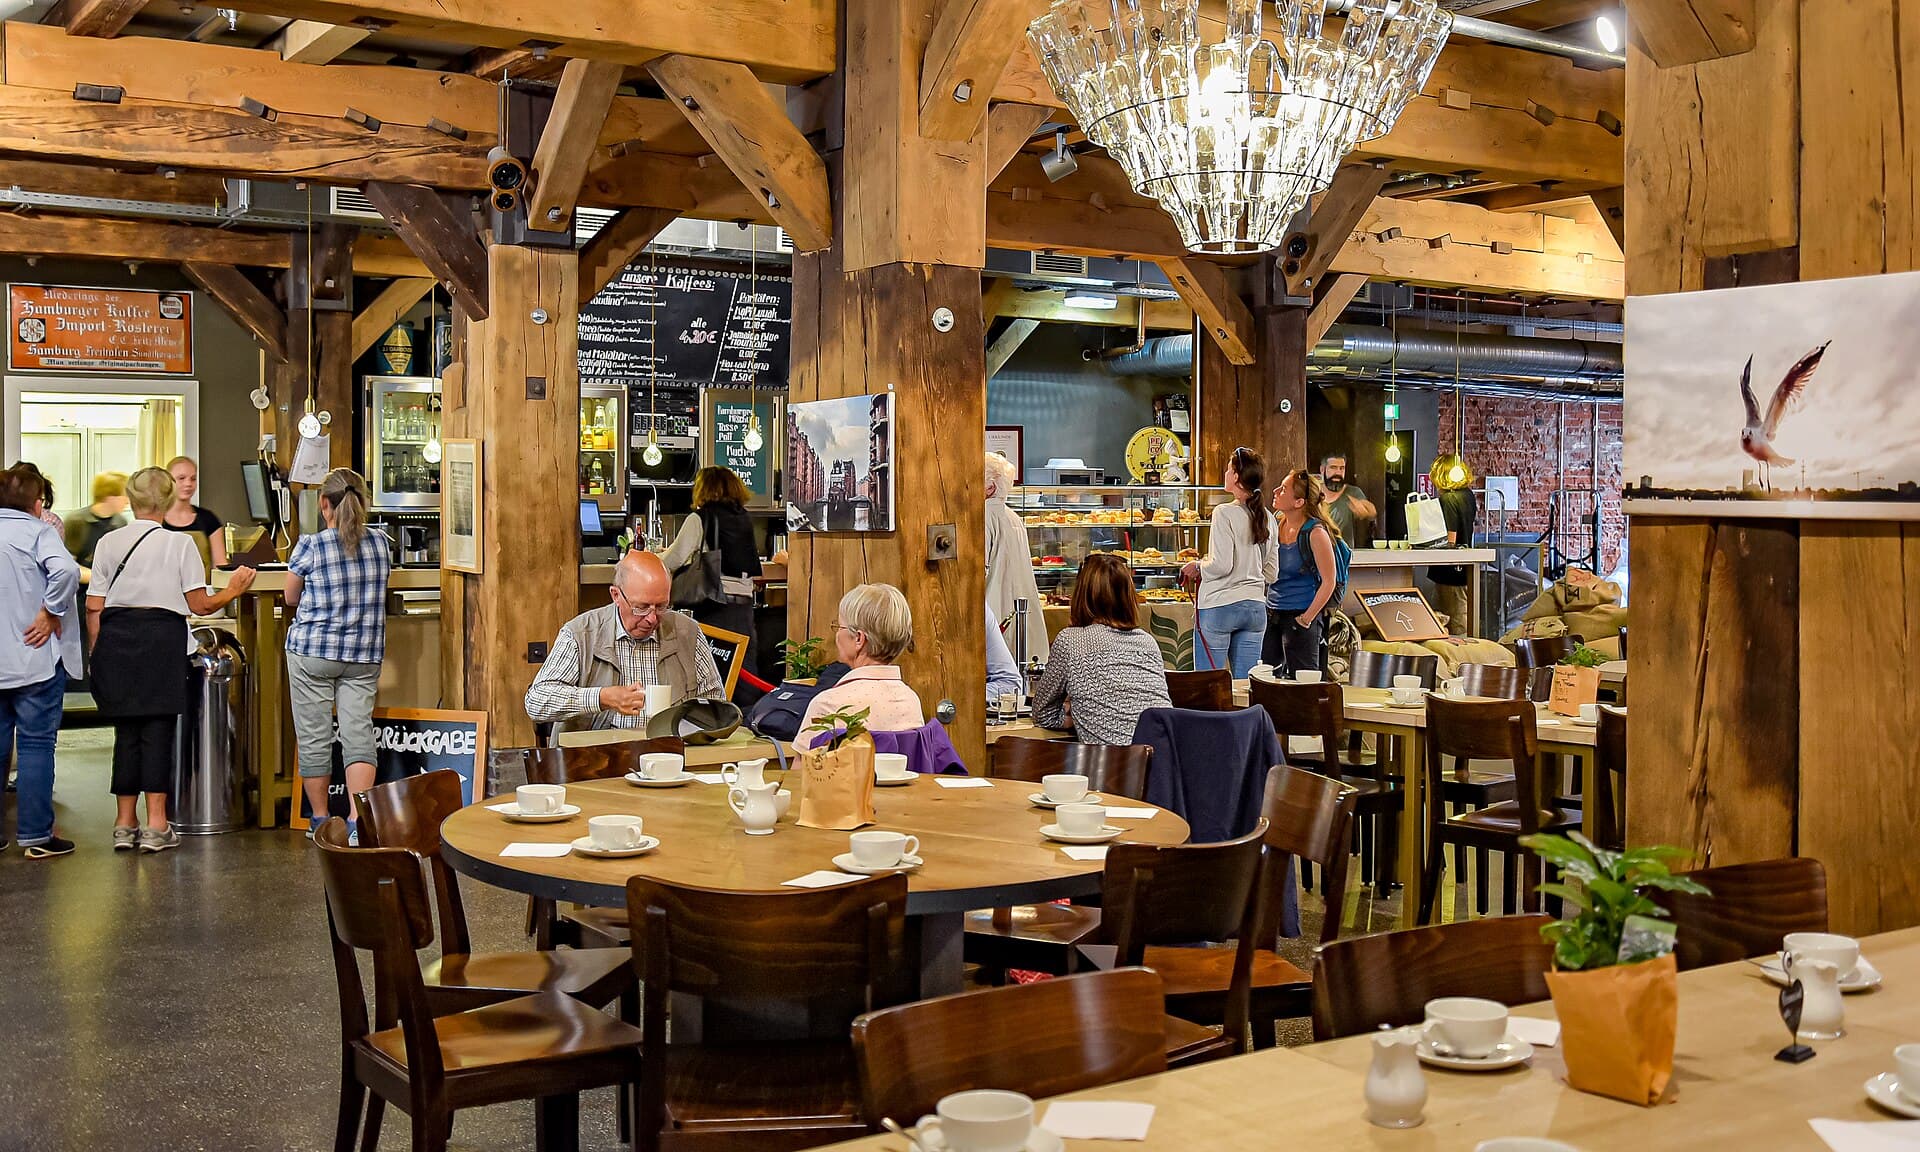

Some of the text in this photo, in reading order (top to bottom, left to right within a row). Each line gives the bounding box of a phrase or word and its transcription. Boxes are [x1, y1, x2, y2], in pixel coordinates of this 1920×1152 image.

[666, 274, 716, 292] Kaffees:
[739, 292, 781, 303] Rartäten:
[20, 301, 99, 319] Hamburger
[690, 317, 707, 328] alle
[26, 343, 81, 358] Hamburg
[717, 423, 739, 432] Tasse
